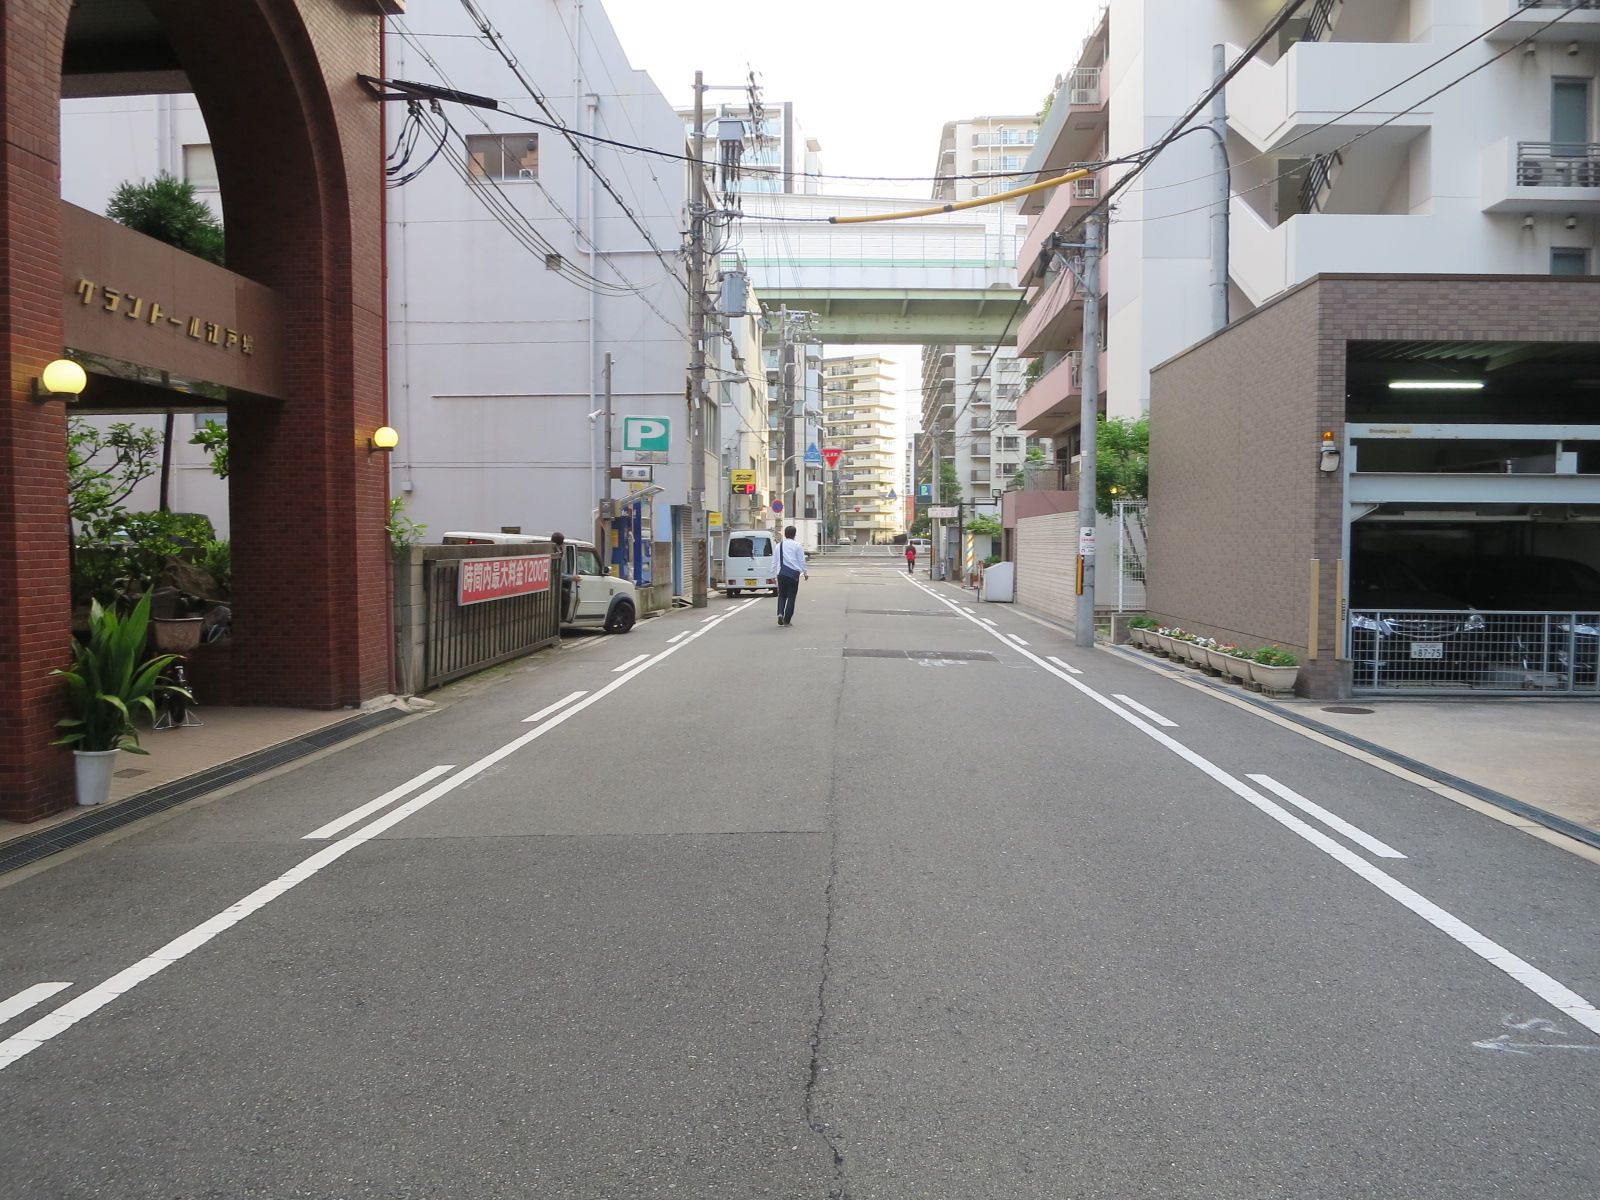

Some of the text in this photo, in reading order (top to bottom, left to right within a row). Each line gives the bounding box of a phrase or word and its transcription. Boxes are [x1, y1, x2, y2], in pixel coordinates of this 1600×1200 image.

[627, 420, 666, 448] P
[746, 484, 755, 494] P
[463, 559, 549, 592] 時間内最大料金1200円
